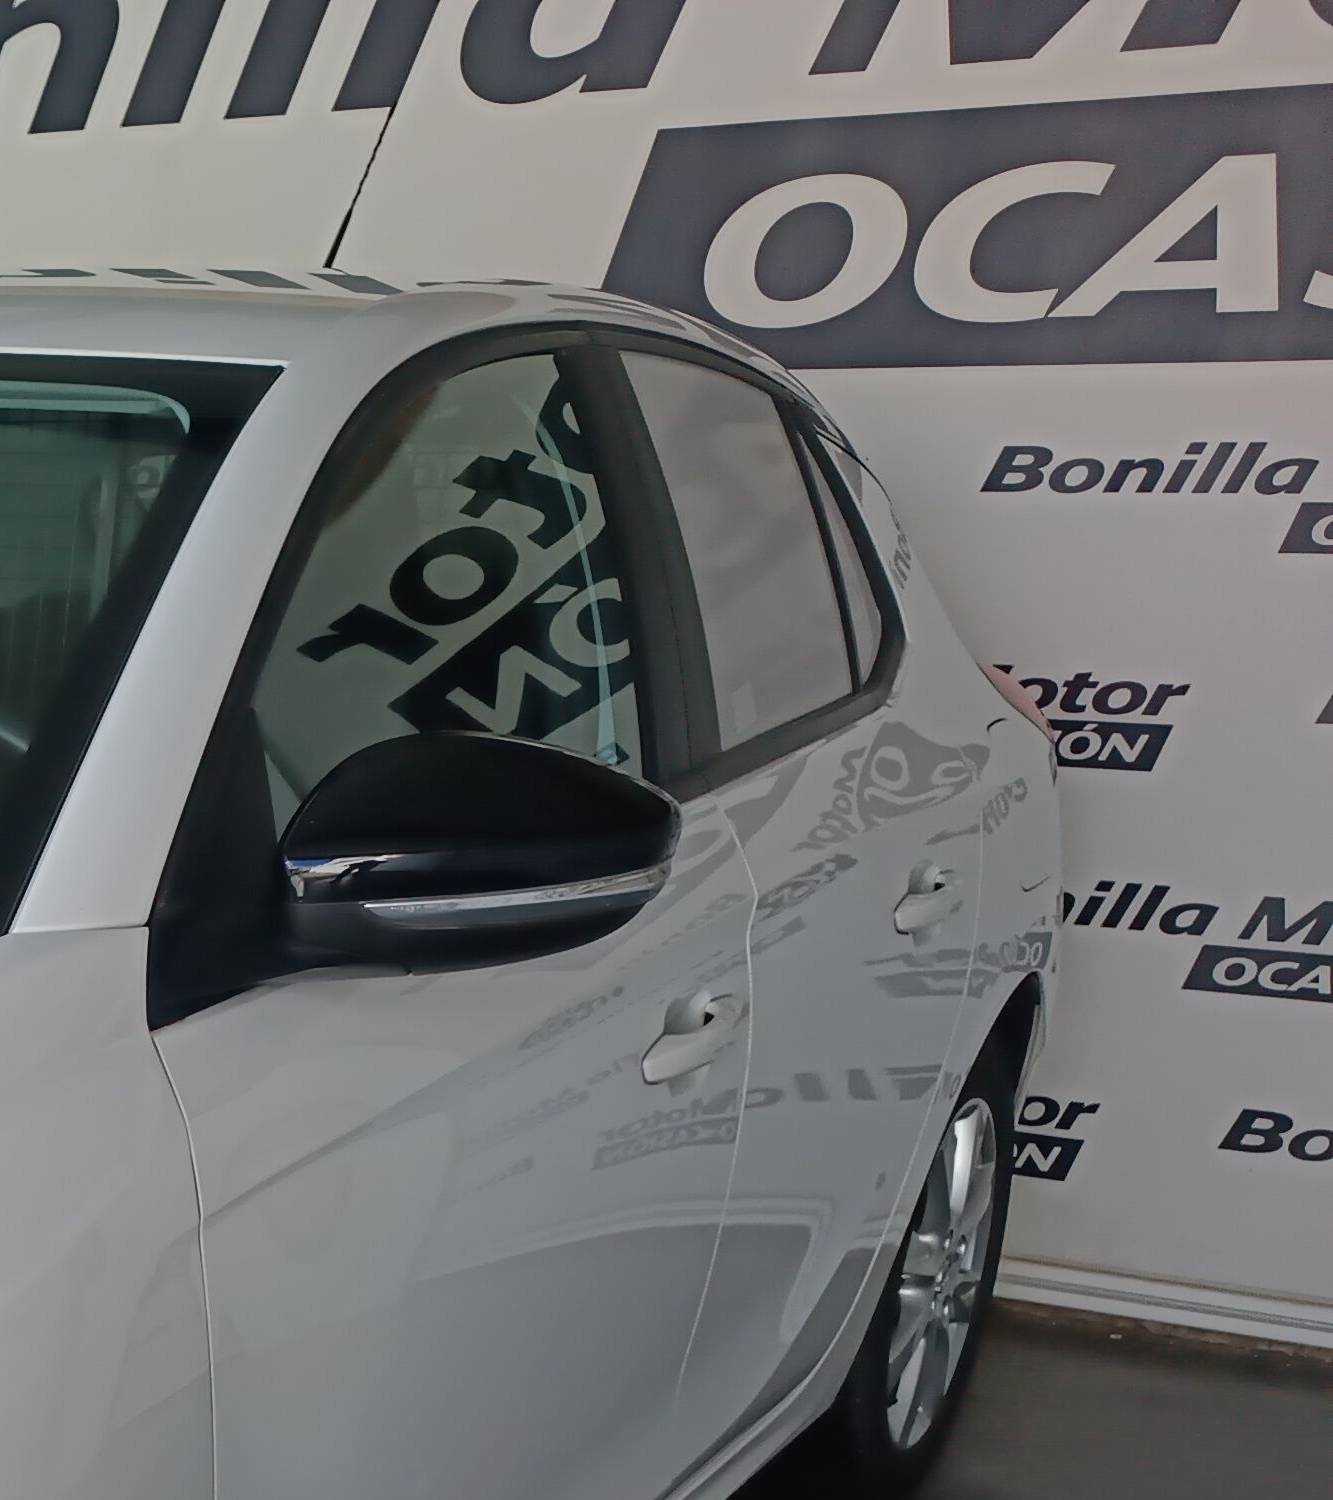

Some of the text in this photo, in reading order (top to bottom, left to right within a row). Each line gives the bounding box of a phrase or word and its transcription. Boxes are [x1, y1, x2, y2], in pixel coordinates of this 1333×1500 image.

[704, 152, 1333, 329] OCA
[980, 442, 1319, 495] Bonilla
[992, 664, 1191, 716] otor
[1063, 881, 1219, 936] illa
